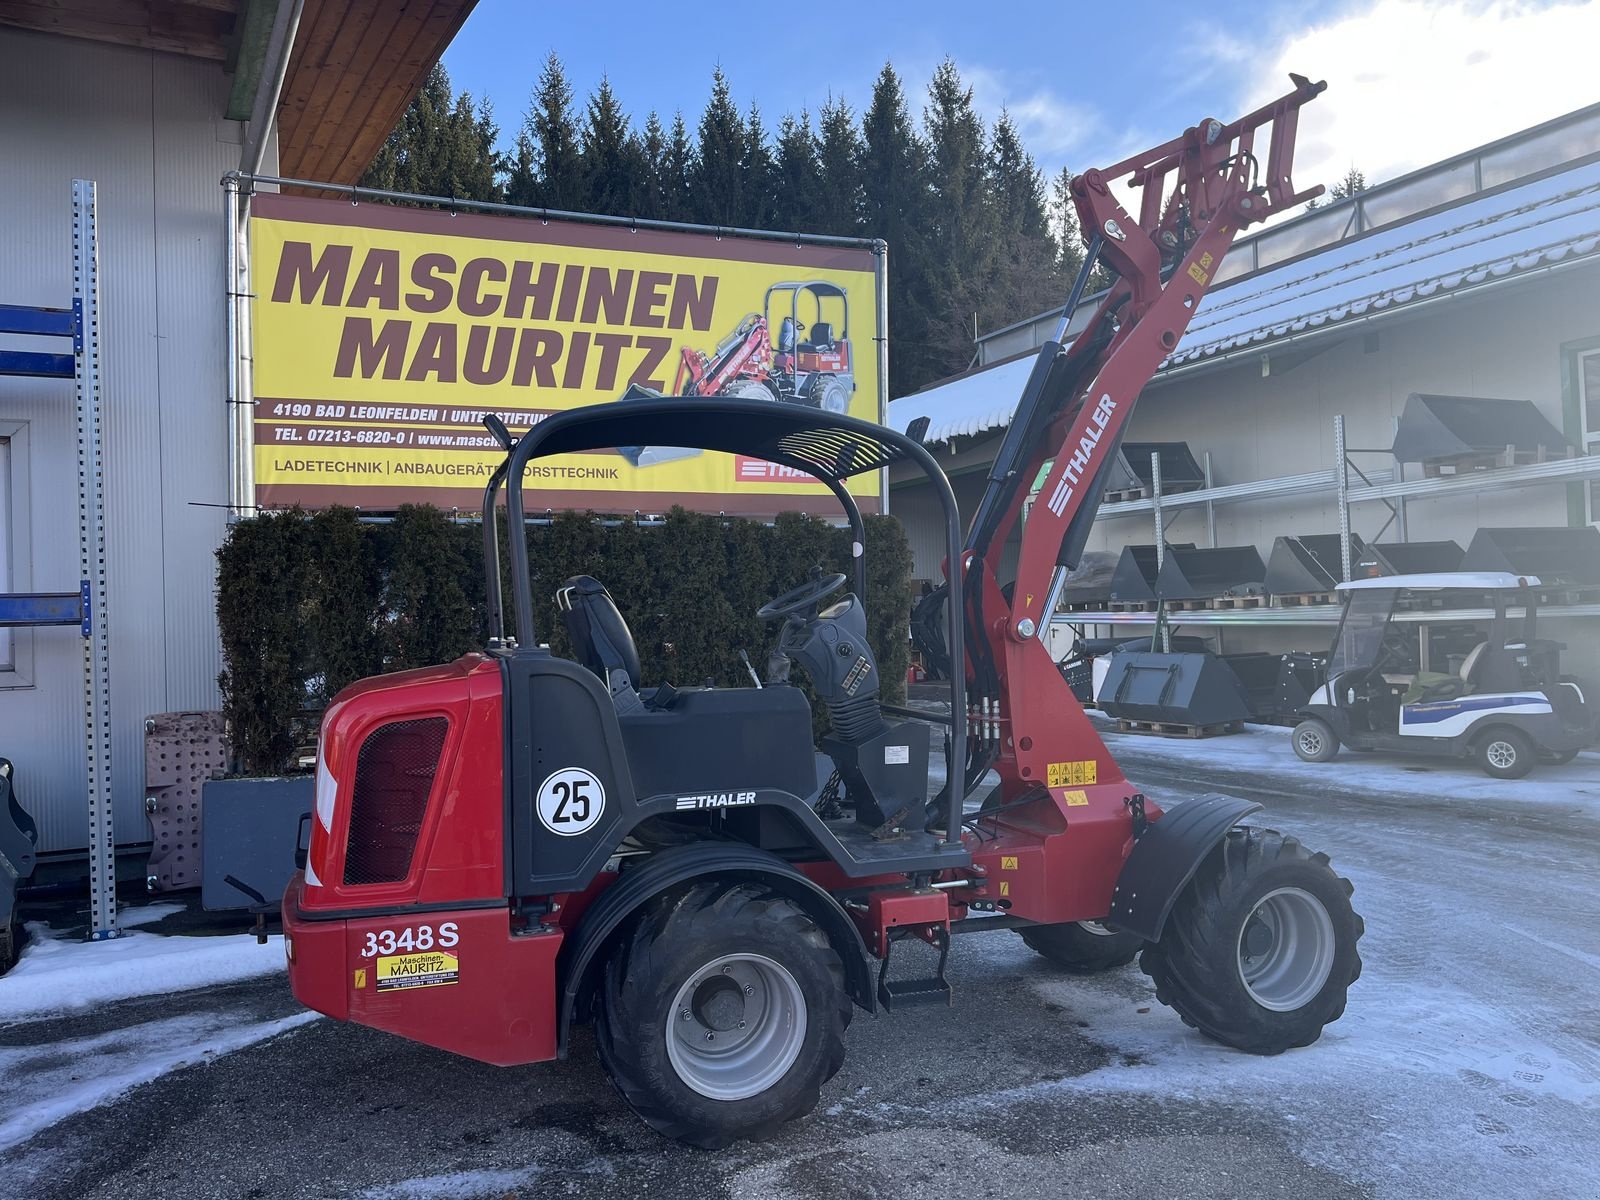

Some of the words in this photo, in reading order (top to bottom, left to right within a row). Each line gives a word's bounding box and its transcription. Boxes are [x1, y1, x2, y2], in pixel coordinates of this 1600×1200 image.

[271, 240, 719, 332] MASCHINEN
[333, 316, 673, 393] MAURITZ
[273, 403, 312, 417] 4190
[315, 404, 346, 418] BAD
[349, 406, 438, 421] LEONFELDEN
[450, 410, 554, 426] UNTESTIFTUN
[275, 428, 303, 441] TEL.
[307, 429, 405, 443] 07213-6820-0
[1061, 393, 1117, 485] THALER
[275, 460, 383, 473] LADETECHNIK
[523, 466, 619, 479] ORSTTECHNIK
[552, 780, 590, 824] 25
[696, 791, 757, 808] THALER
[361, 926, 435, 957] 3348
[438, 922, 460, 947] S
[390, 960, 444, 977] MAURITZ
[400, 955, 444, 965] Maschinen-
